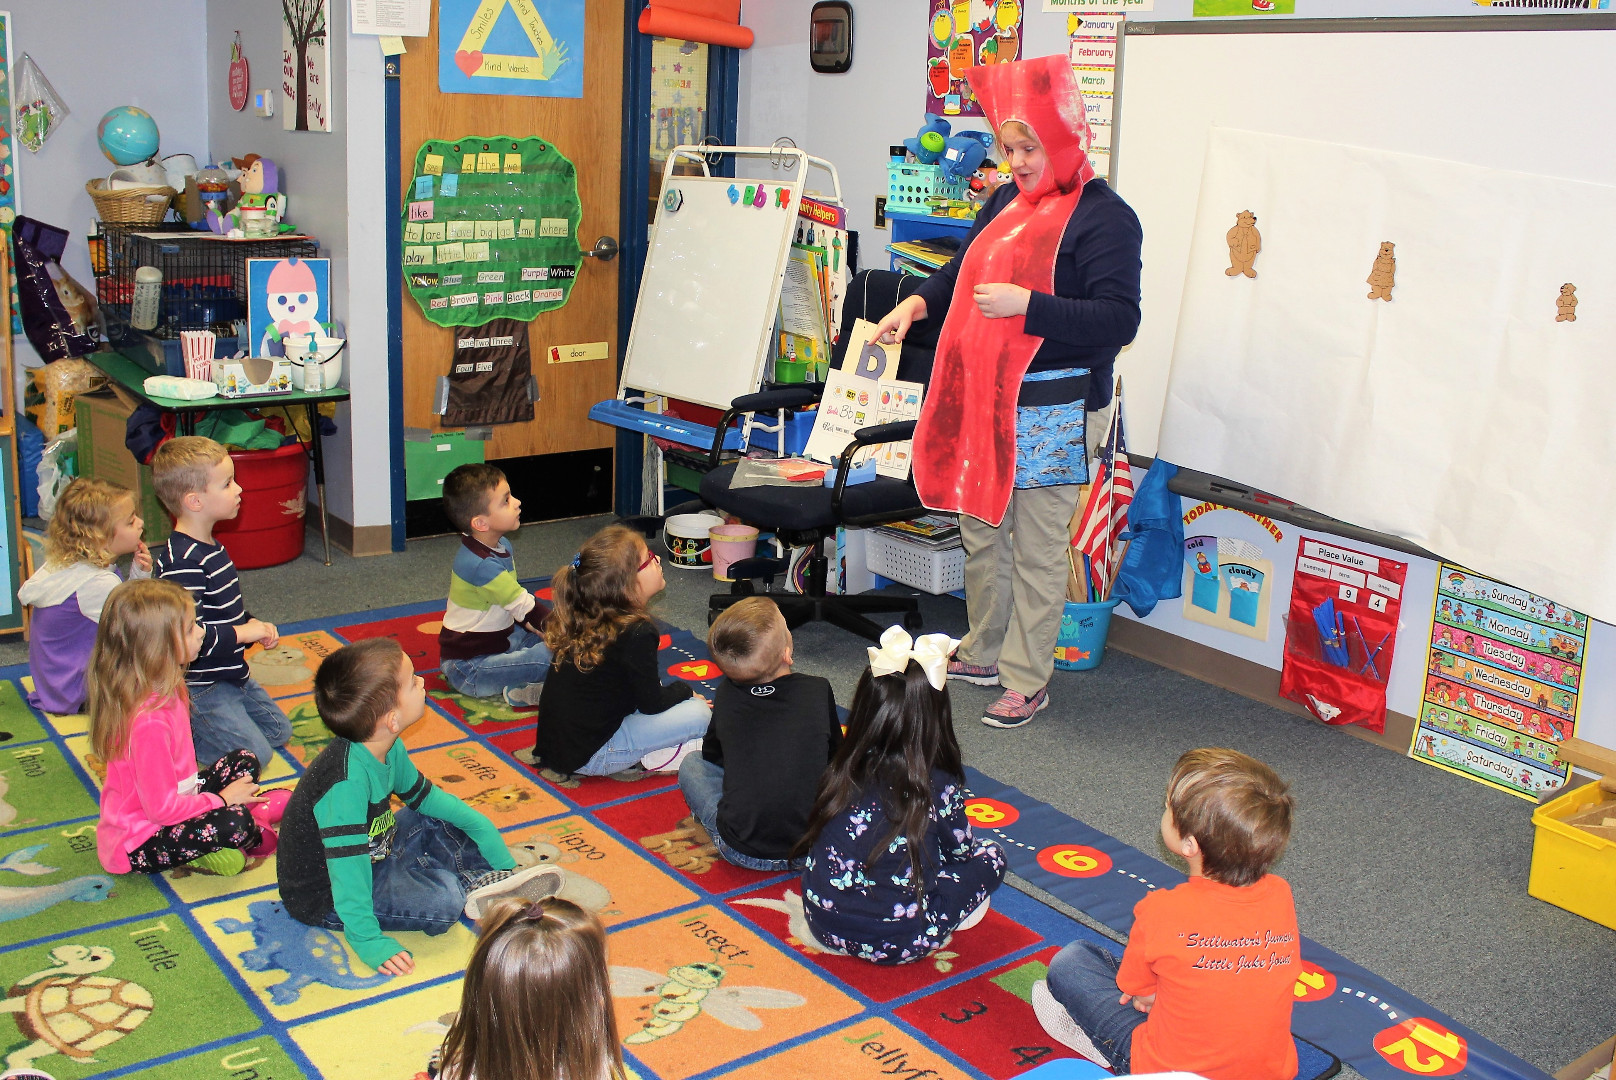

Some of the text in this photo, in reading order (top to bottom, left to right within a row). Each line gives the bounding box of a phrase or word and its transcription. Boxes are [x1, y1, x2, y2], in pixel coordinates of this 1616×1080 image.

[471, 8, 494, 40] Smiles
[1083, 20, 1115, 30] January
[1079, 48, 1114, 58] February
[484, 61, 530, 73] Kind Words
[1081, 76, 1106, 85] March
[411, 205, 429, 219] like
[813, 204, 835, 222] Helpers
[405, 226, 419, 240] to
[425, 231, 441, 240] are
[541, 220, 568, 235] where
[405, 249, 425, 265] play
[443, 276, 462, 284] Blue
[479, 273, 504, 281] Green
[522, 269, 548, 280] Purple
[550, 267, 575, 277] White
[431, 290, 562, 307] Red Brown Pink Black Orange
[459, 337, 513, 348] One Two Three
[570, 348, 587, 358] door
[477, 363, 492, 371] Five
[1187, 539, 1204, 549] cold
[1318, 547, 1364, 566] Place Value
[1228, 566, 1257, 579] cloudy
[1345, 589, 1352, 599] 9
[1374, 599, 1380, 607] 4
[1491, 588, 1528, 611] Sunday
[1488, 619, 1530, 642] Monday
[1483, 642, 1525, 667] Tuesday
[1474, 667, 1531, 697] Wednesday
[1474, 694, 1523, 722] Thursday
[1475, 724, 1508, 747] Friday
[12, 747, 46, 778] Rhino
[446, 747, 499, 781] Giraffe
[1466, 750, 1514, 778] Saturday
[965, 803, 1005, 823] 8
[61, 825, 97, 854] Seal
[547, 821, 606, 861] Hippo
[129, 920, 180, 972] Turtle
[679, 912, 751, 962] Insect
[1191, 954, 1234, 970] Little
[1235, 954, 1267, 974] Juke
[939, 1000, 988, 1025] 3
[1009, 1045, 1054, 1067] 4
[1380, 1024, 1461, 1073] 12
